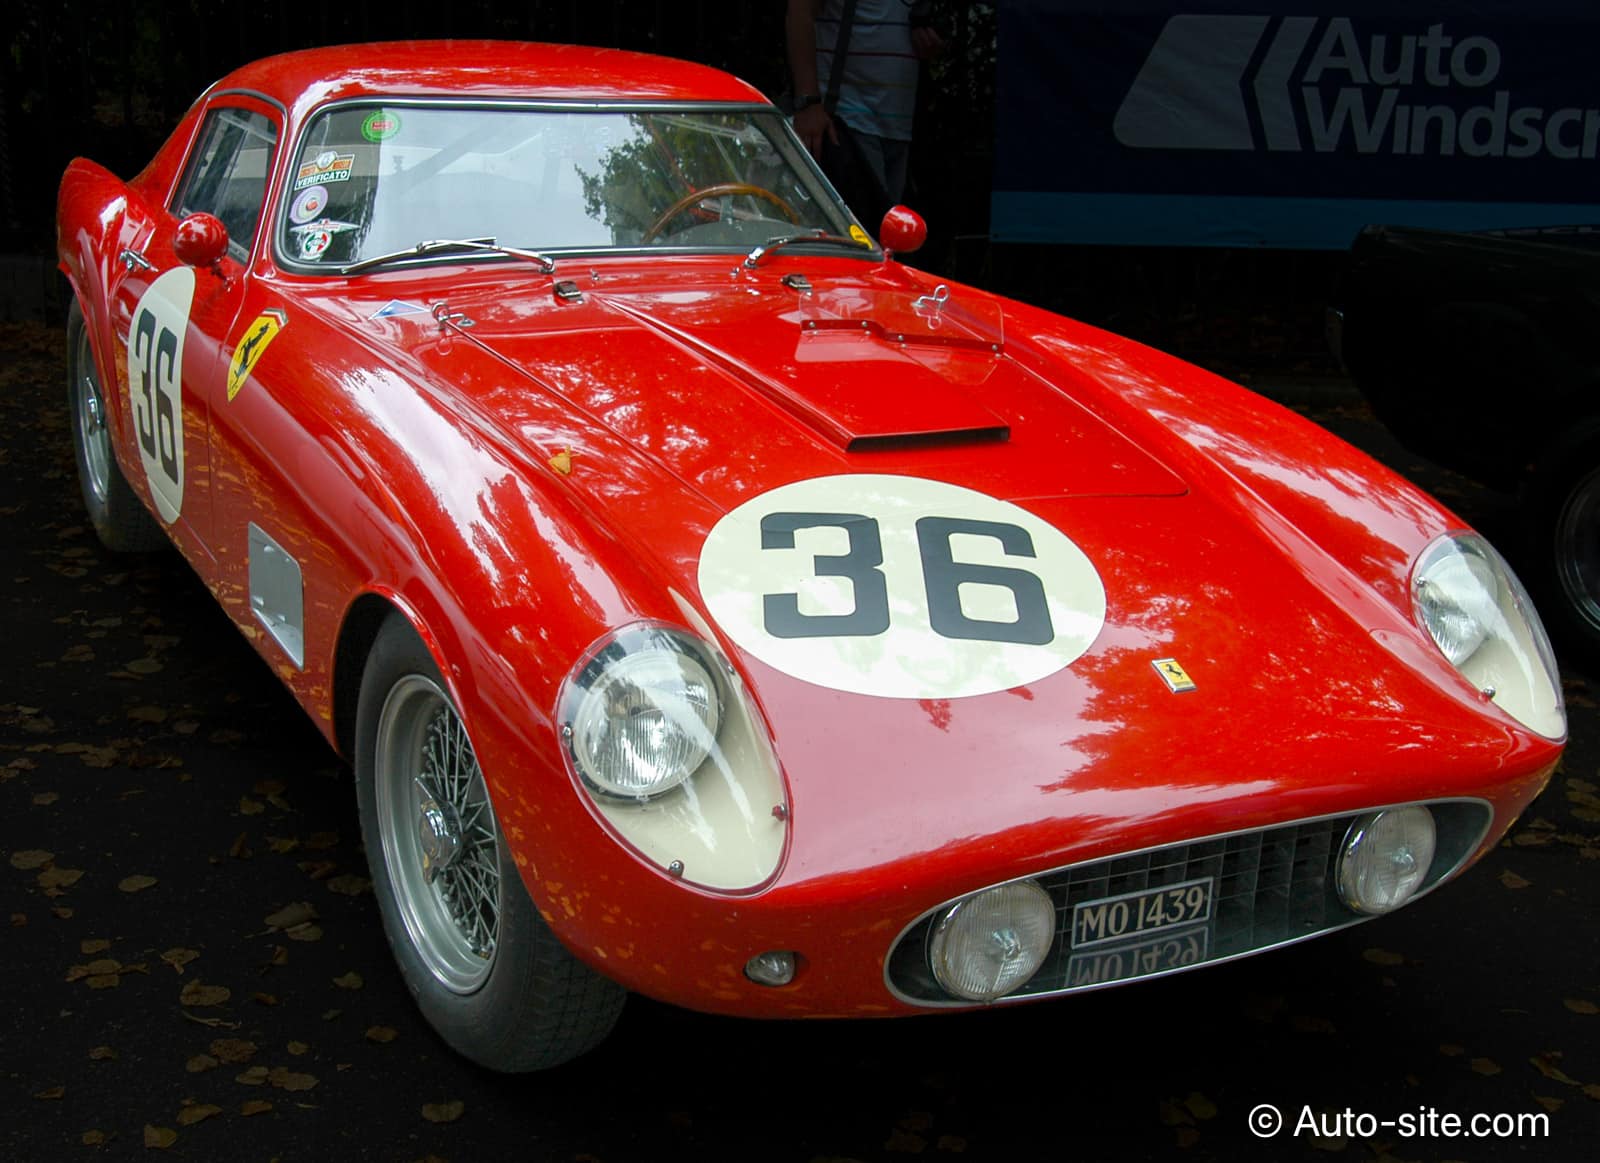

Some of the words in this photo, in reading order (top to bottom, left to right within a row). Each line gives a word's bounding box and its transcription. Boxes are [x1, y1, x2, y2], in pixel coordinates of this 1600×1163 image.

[1302, 17, 1501, 87] Auto
[1302, 86, 1600, 159] Windscr
[298, 170, 348, 187] VERIFICATO
[135, 308, 178, 485] 36
[760, 512, 1055, 646] 36
[1080, 902, 1129, 942] MO
[1135, 886, 1205, 930] 1439
